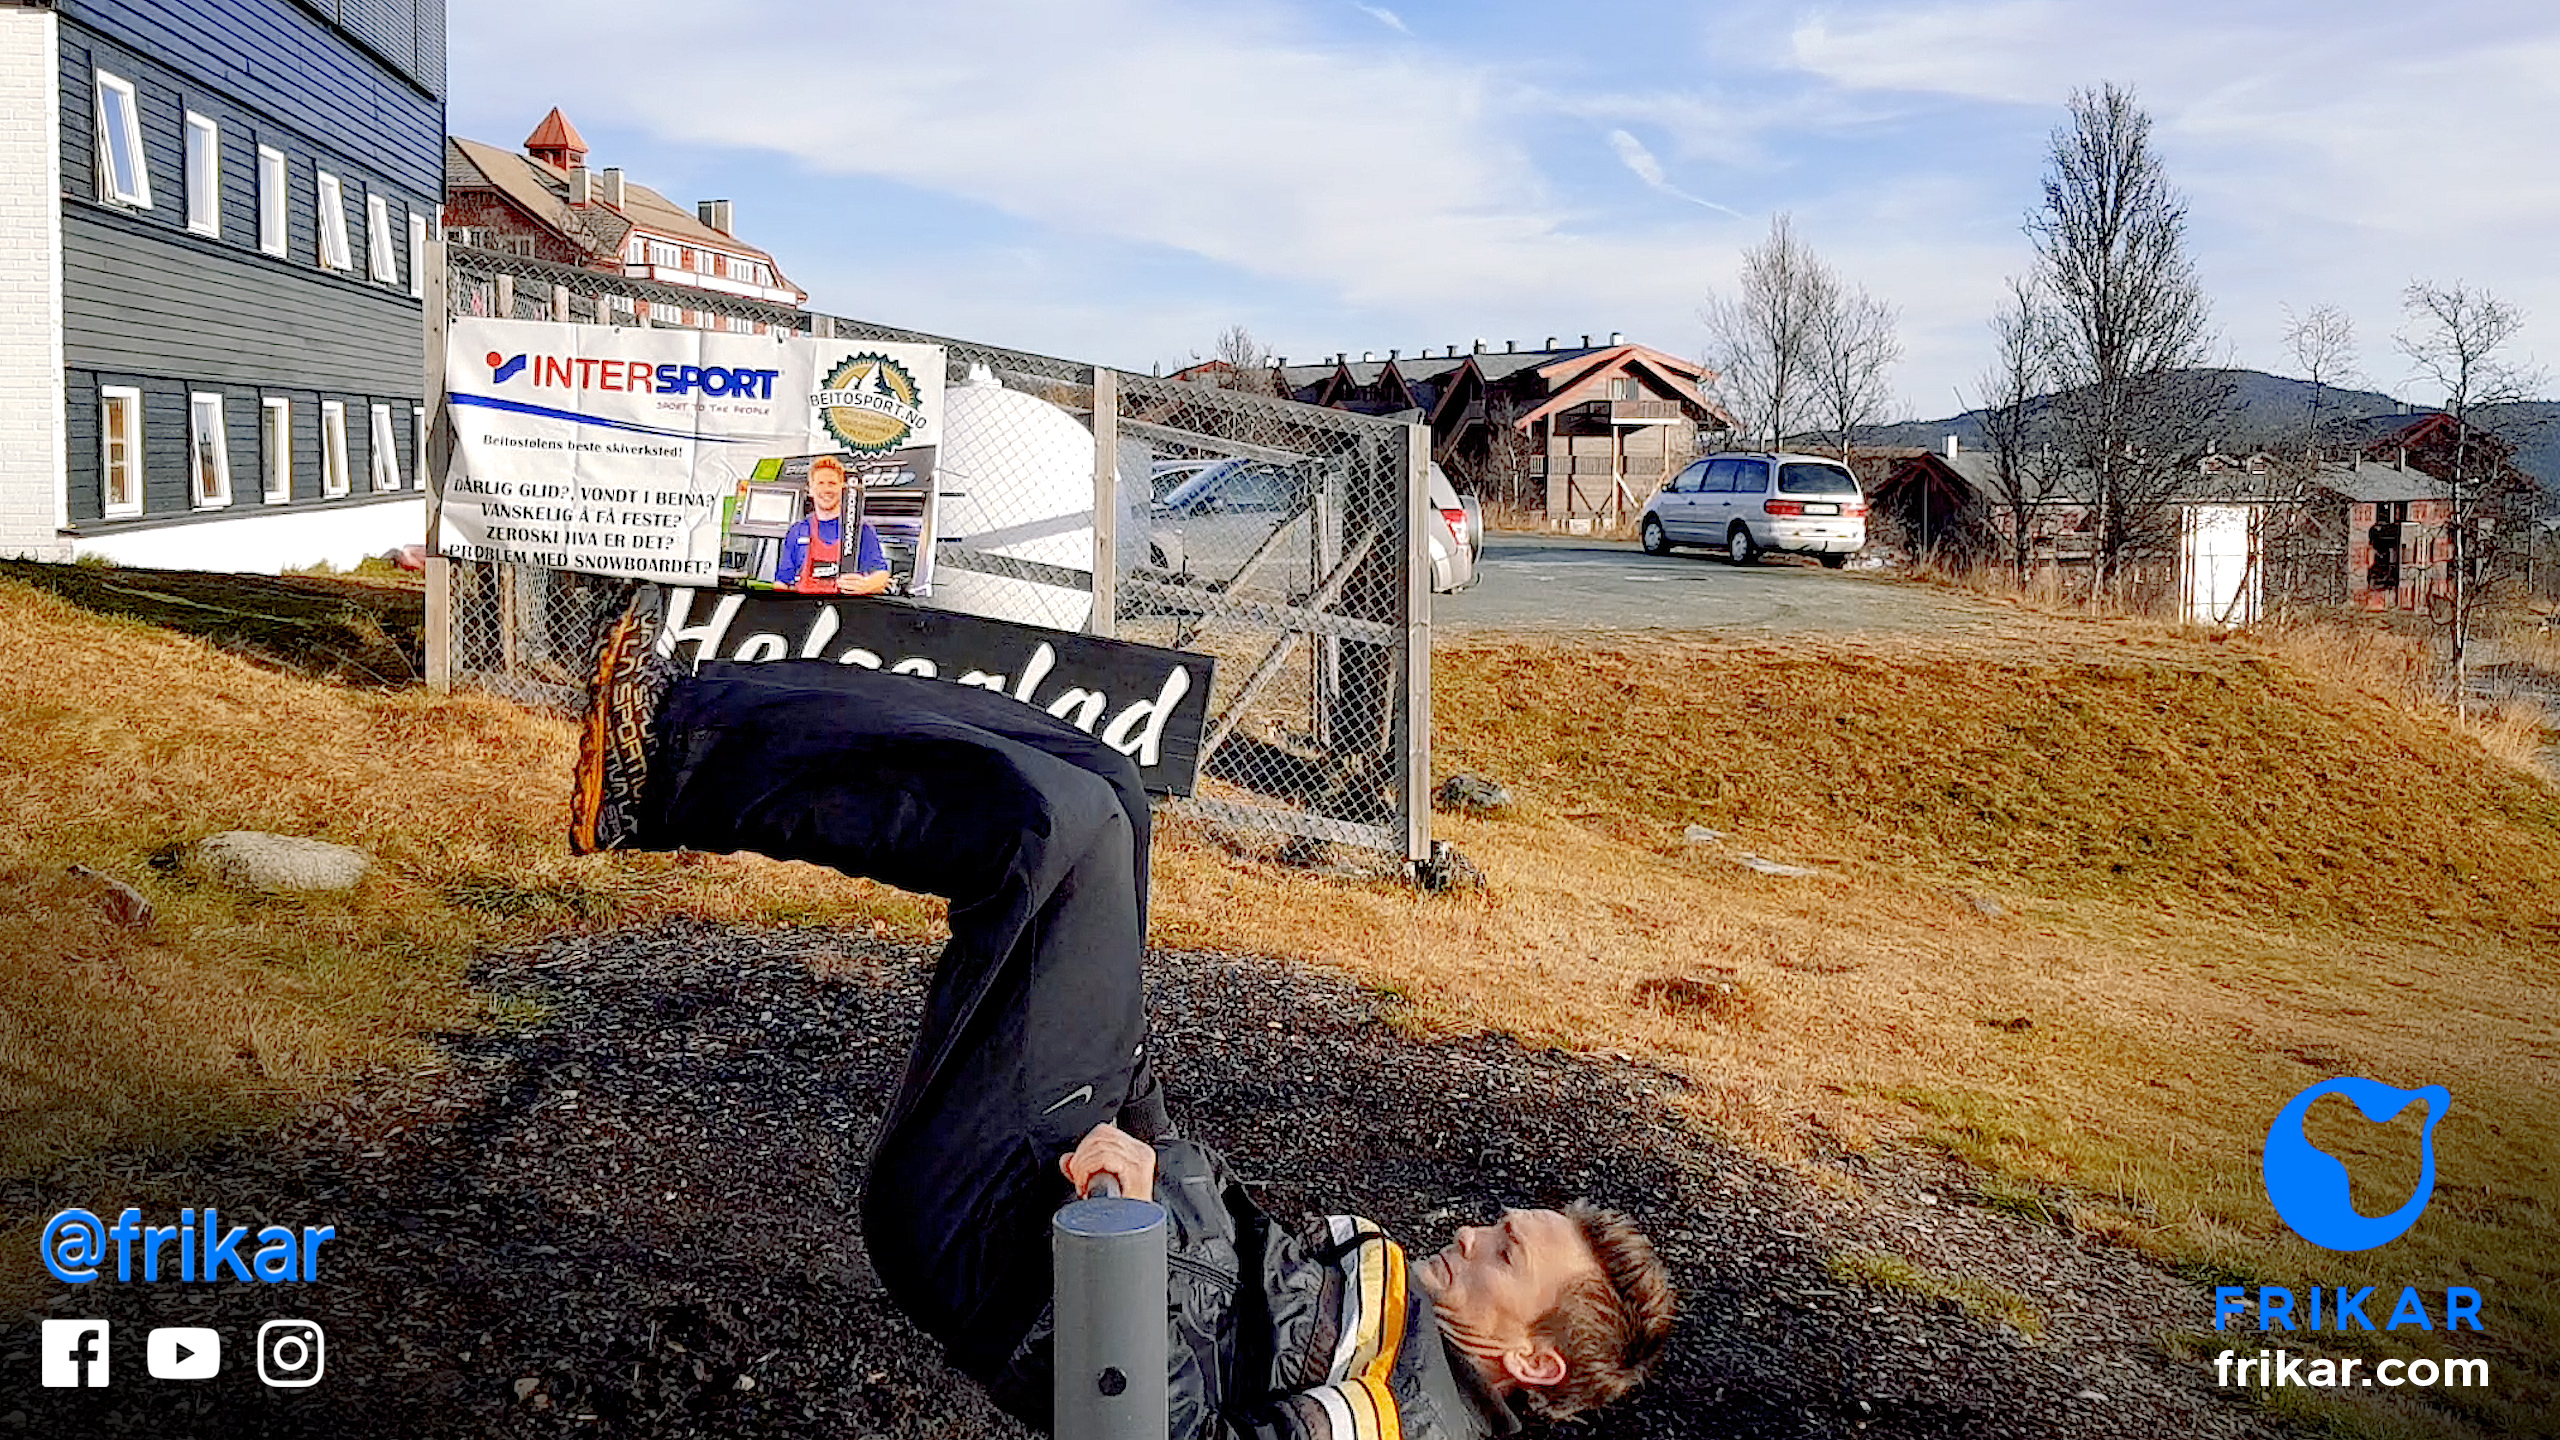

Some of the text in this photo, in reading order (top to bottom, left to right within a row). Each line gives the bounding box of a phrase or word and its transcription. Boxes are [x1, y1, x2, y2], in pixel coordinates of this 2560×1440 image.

[534, 354, 779, 400] INTERSPORT
[656, 401, 689, 411] SPORT
[692, 403, 706, 412] TO
[810, 392, 927, 429] BEITOSPORT.NO
[568, 440, 602, 453] beste
[606, 443, 682, 458] skiverksted!
[454, 475, 513, 496] DÅRLIG
[581, 487, 639, 504] VONDT
[644, 490, 649, 504] I
[656, 491, 716, 508] BEINA?
[481, 502, 682, 529] VANSKELIG Å FÅ FESTE?
[486, 525, 675, 550] ZEROSKI HVA ER DET?
[532, 551, 569, 567] MED
[574, 554, 713, 574] SNOWBOARDET?
